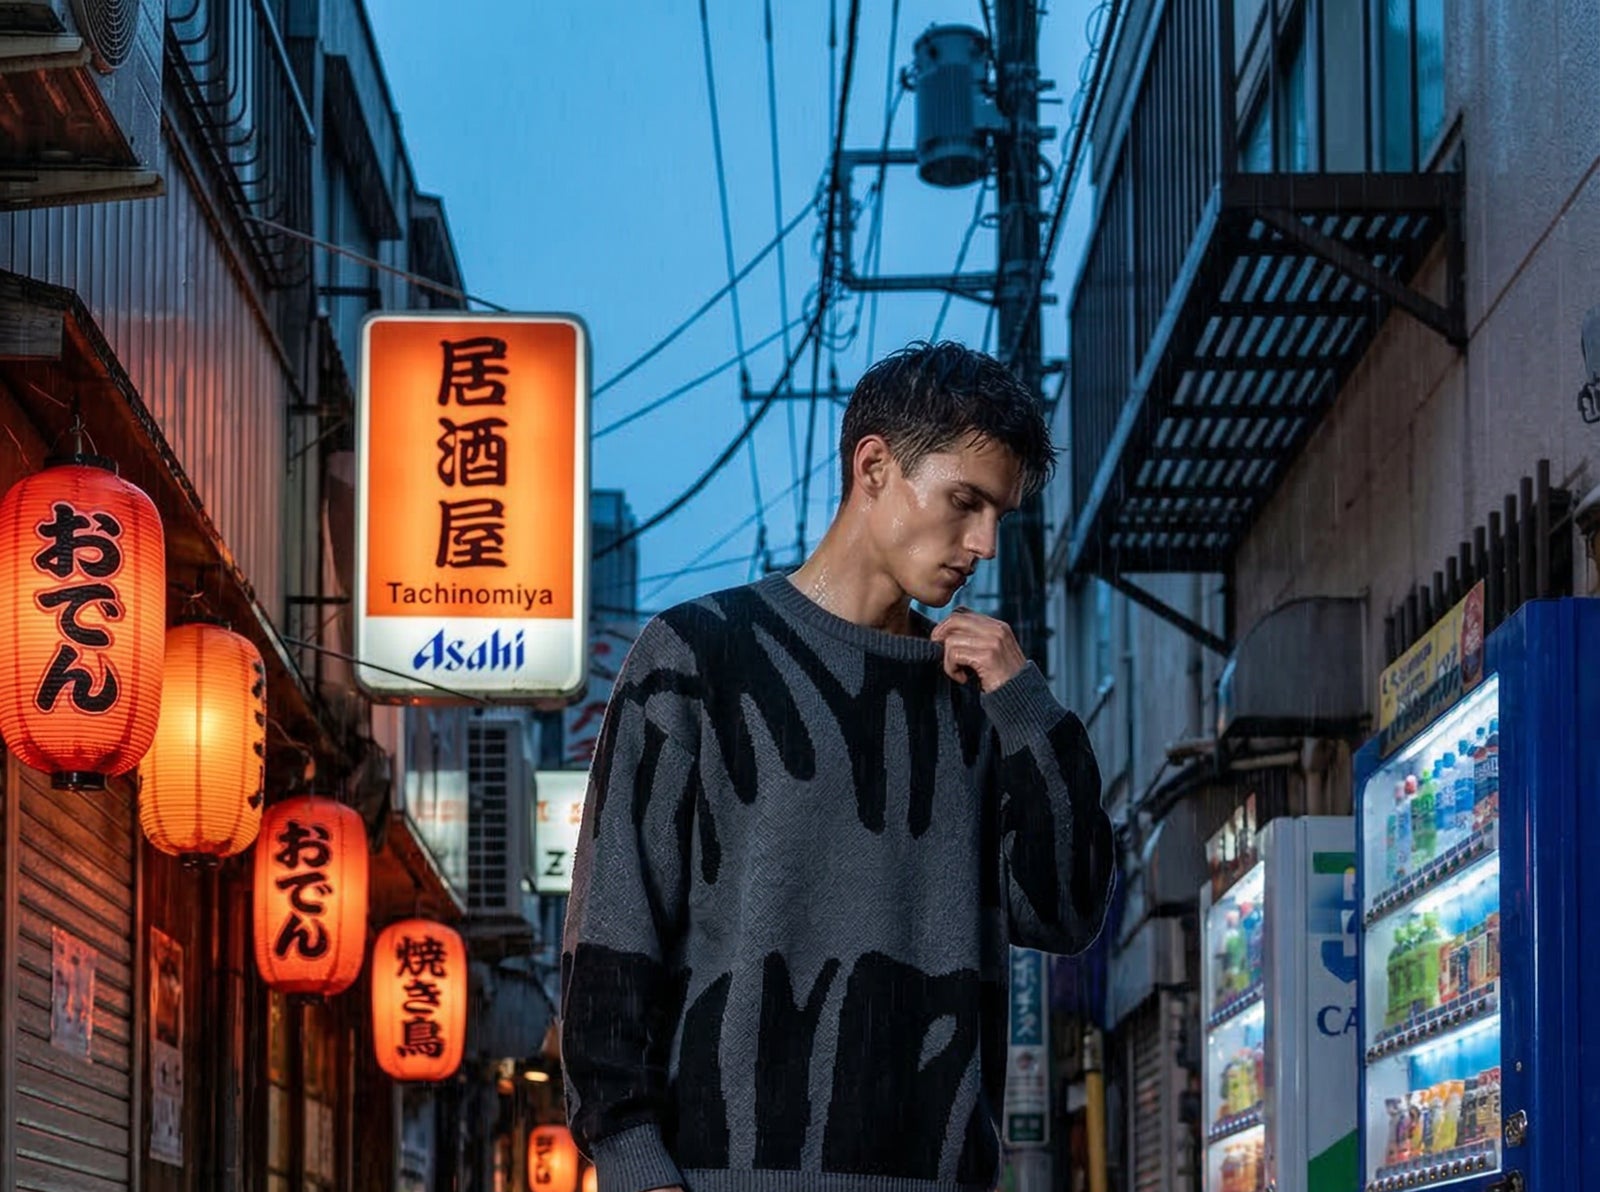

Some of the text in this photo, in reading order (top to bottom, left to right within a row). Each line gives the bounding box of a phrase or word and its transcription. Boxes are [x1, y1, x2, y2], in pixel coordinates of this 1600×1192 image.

[436, 336, 510, 568] 居酒屋
[34, 502, 123, 713] おでん
[387, 582, 553, 610] Tachinomiya
[412, 627, 525, 671] Asahi
[275, 820, 332, 959] おでん
[396, 936, 446, 1058] 焼き鳥
